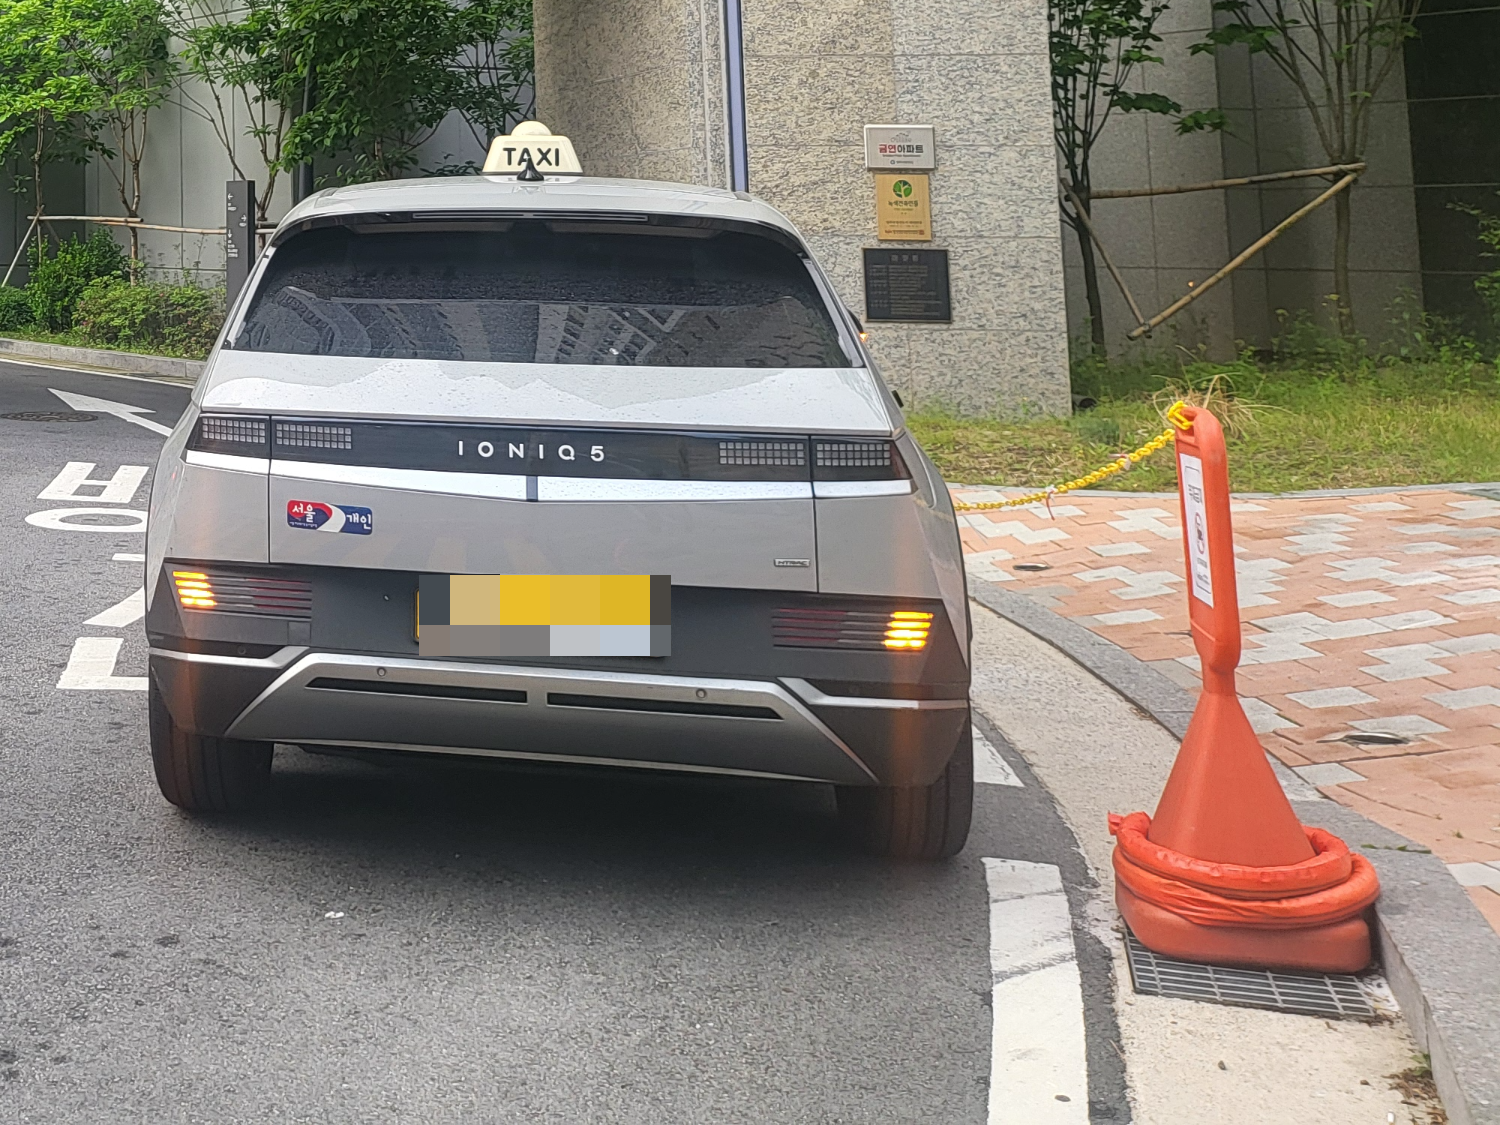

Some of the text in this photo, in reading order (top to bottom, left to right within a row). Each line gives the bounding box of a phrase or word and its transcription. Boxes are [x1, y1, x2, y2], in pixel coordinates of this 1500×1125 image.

[503, 148, 559, 166] TAXI
[879, 143, 924, 153] 금연아파트
[458, 440, 605, 462] IONIQ 5
[292, 503, 372, 530] 서울 개인
